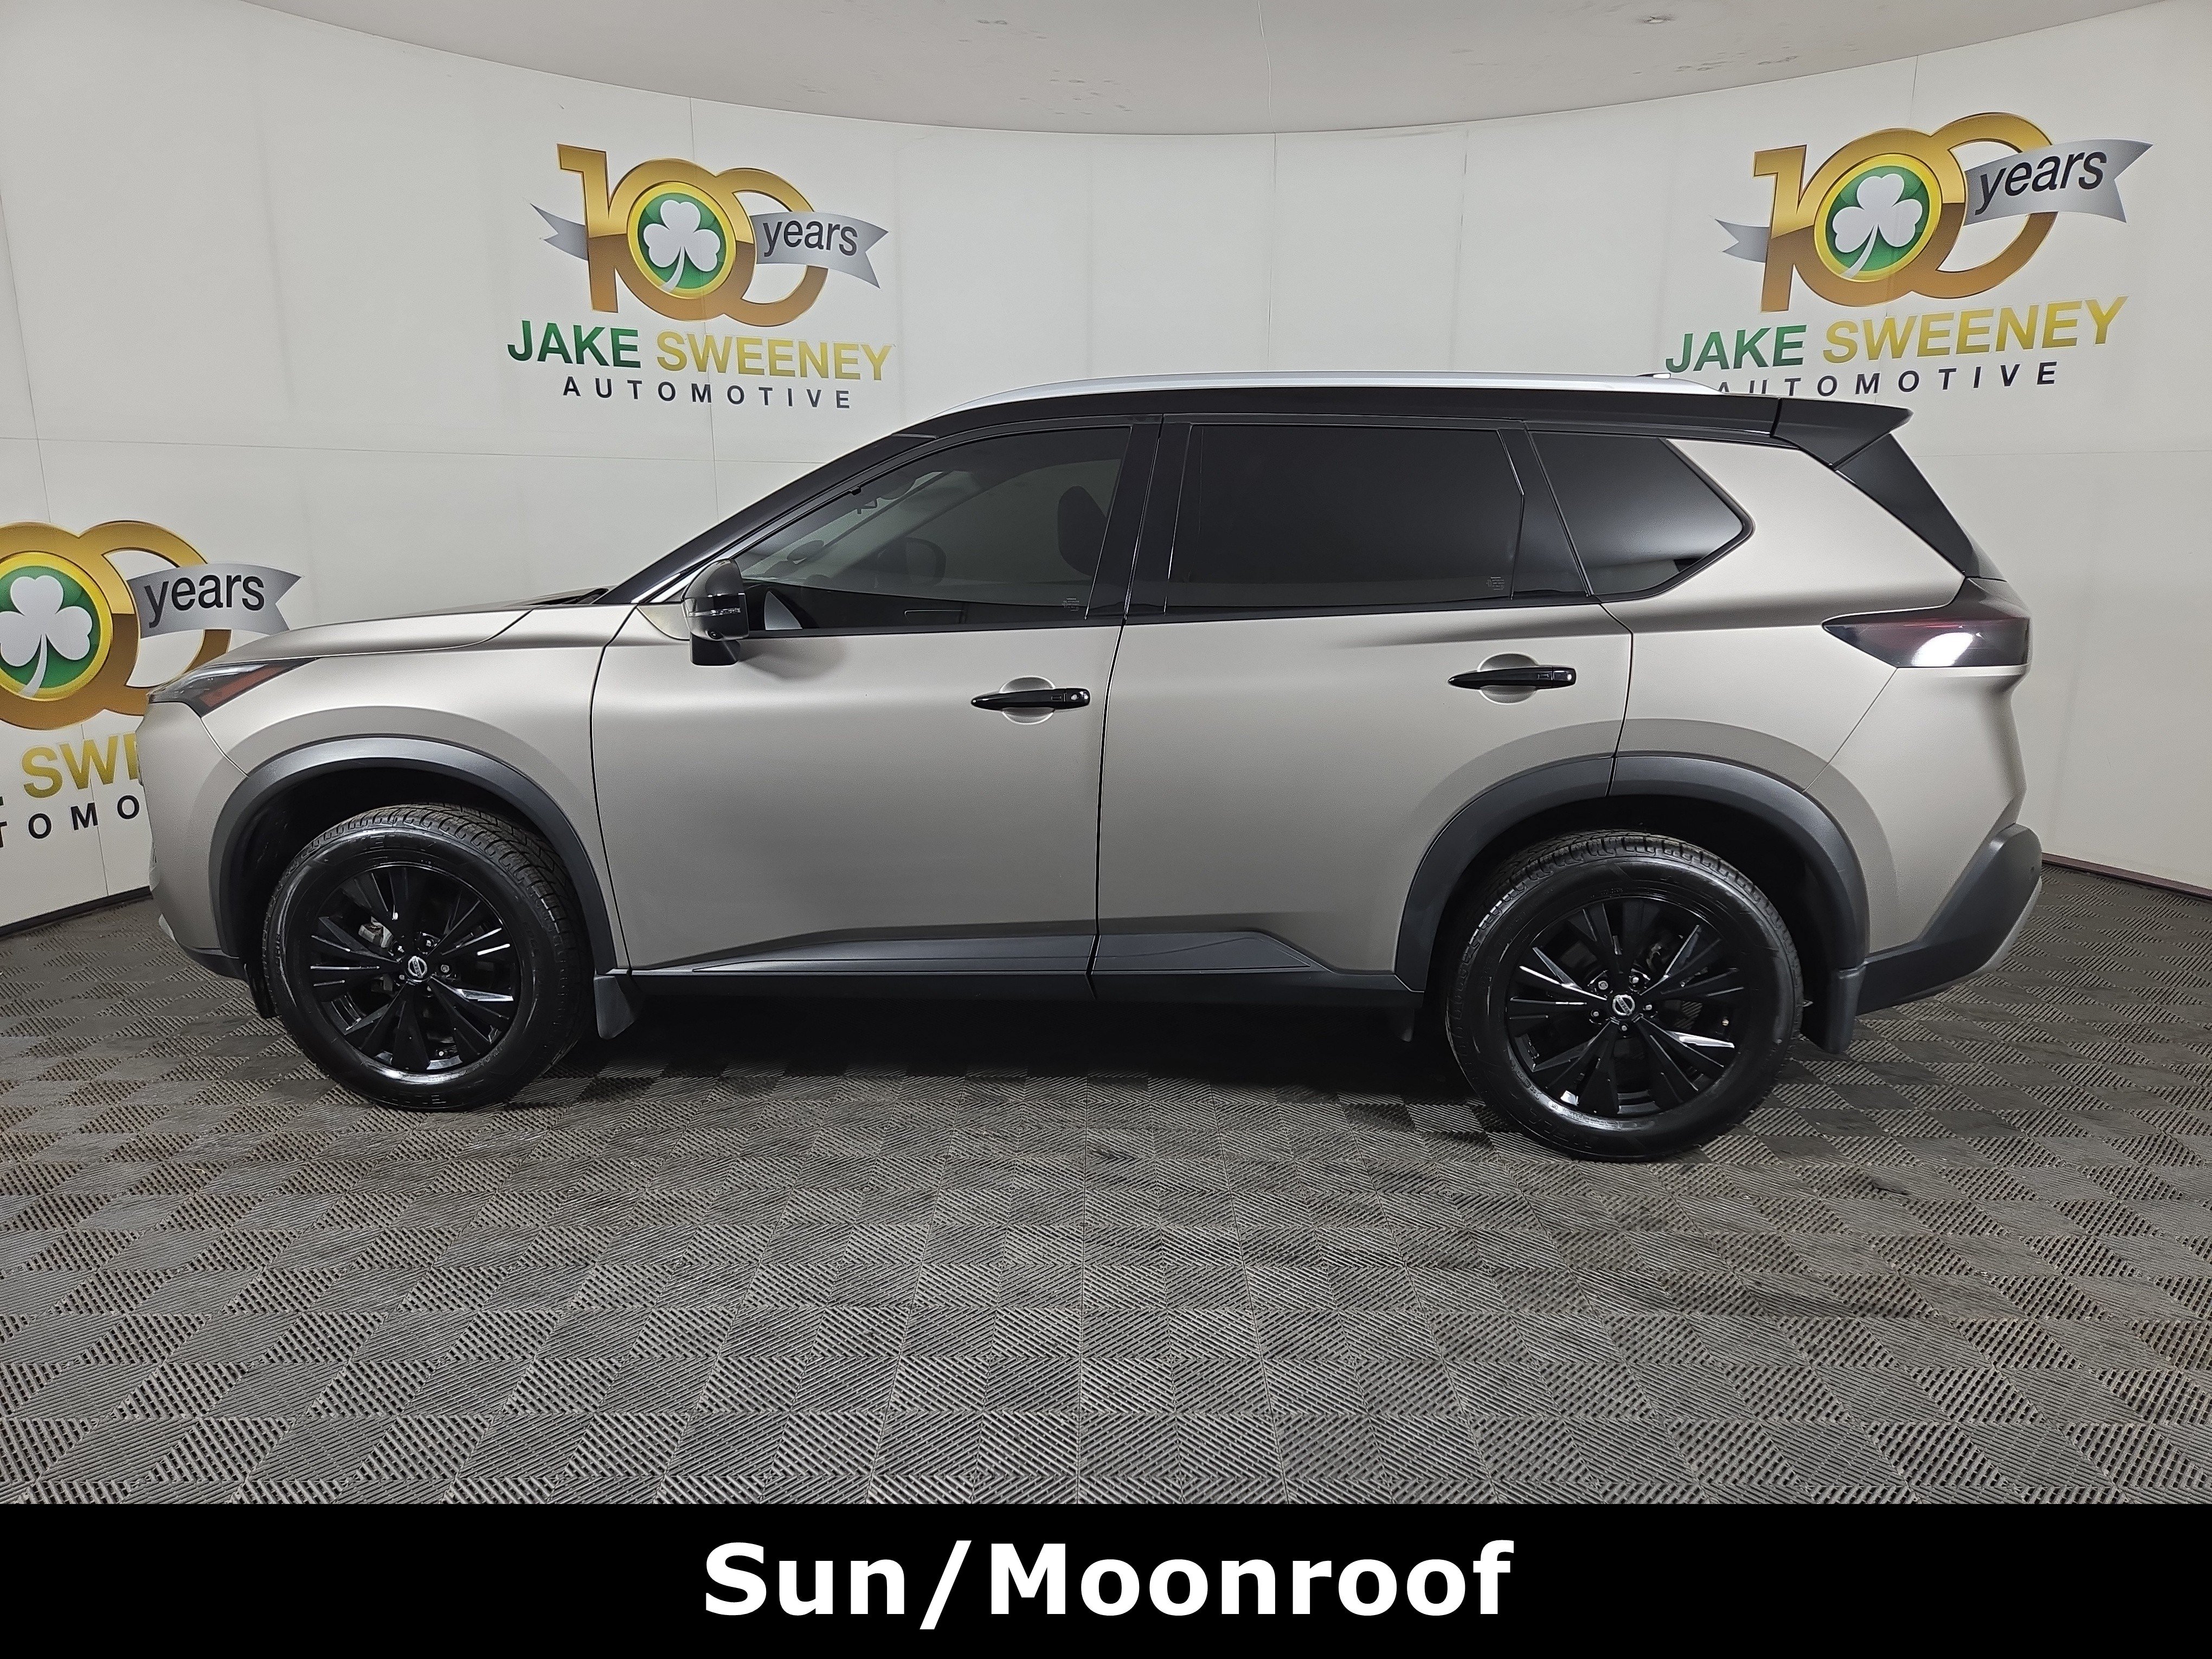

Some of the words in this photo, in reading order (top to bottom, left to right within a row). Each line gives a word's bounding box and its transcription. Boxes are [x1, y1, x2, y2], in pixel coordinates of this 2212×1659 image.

[1975, 151, 2107, 215] years
[762, 220, 858, 257] years
[507, 320, 641, 368] JAKE
[656, 331, 892, 381] SWEENEY
[1665, 324, 1807, 373] JAKE
[1822, 295, 2129, 364] SWEENEY
[563, 376, 850, 409] AUTOMOTIVE
[144, 574, 265, 629] years
